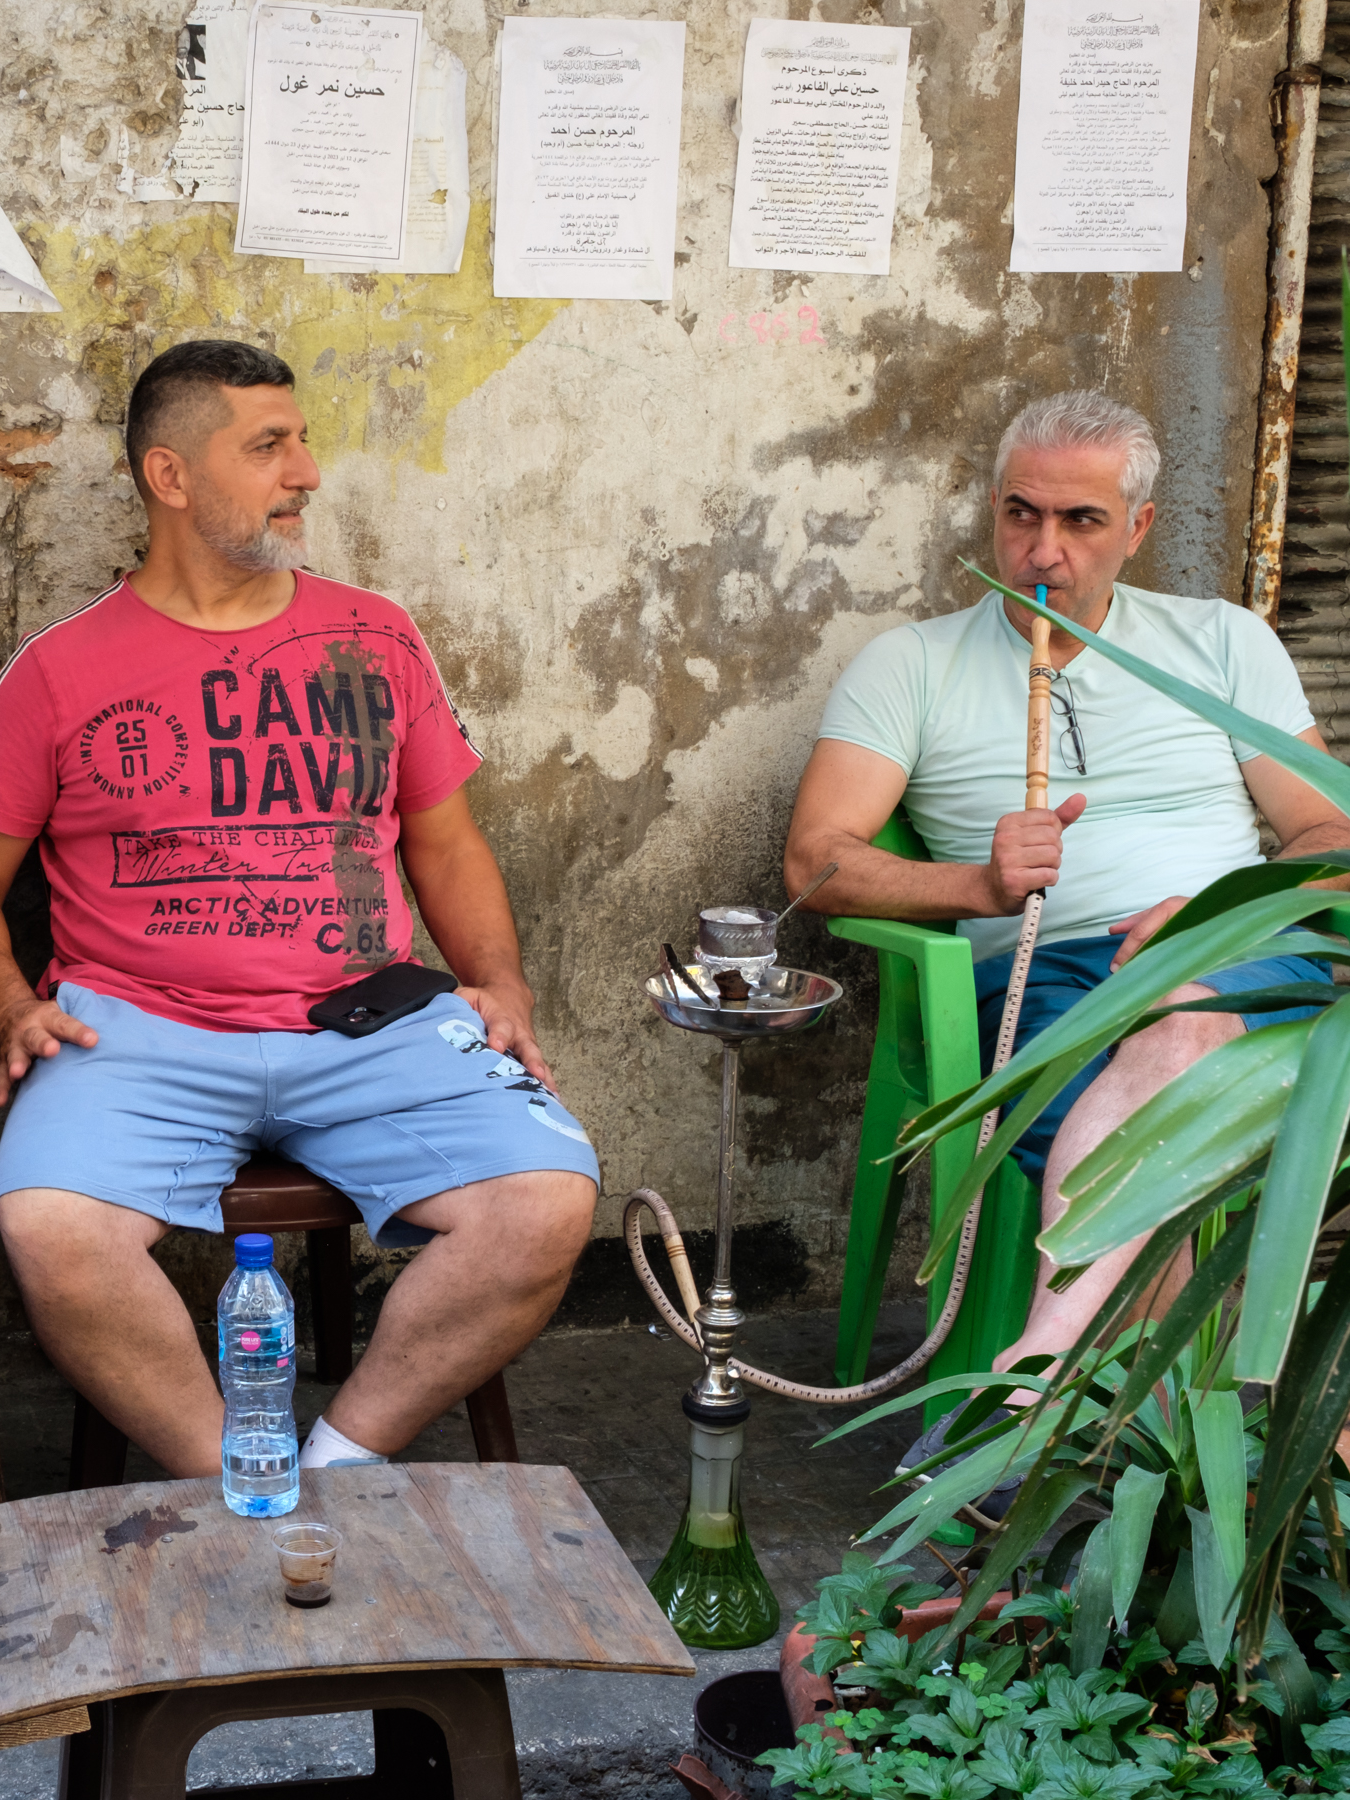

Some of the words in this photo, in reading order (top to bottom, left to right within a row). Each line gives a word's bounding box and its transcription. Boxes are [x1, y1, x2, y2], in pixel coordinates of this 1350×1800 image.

[201, 668, 395, 741] CAMP
[115, 719, 146, 744] 25
[80, 699, 162, 765] INTERNATIONAL
[143, 714, 189, 796] COMPETITION
[121, 753, 148, 778] 01
[87, 767, 135, 800] ANNUAL
[209, 742, 390, 818] DAVID
[124, 834, 182, 855] TAKE
[193, 831, 241, 846] THE
[150, 897, 252, 918] ARCTIC
[262, 898, 389, 917] ADVENTURE
[144, 921, 220, 937] GREEN
